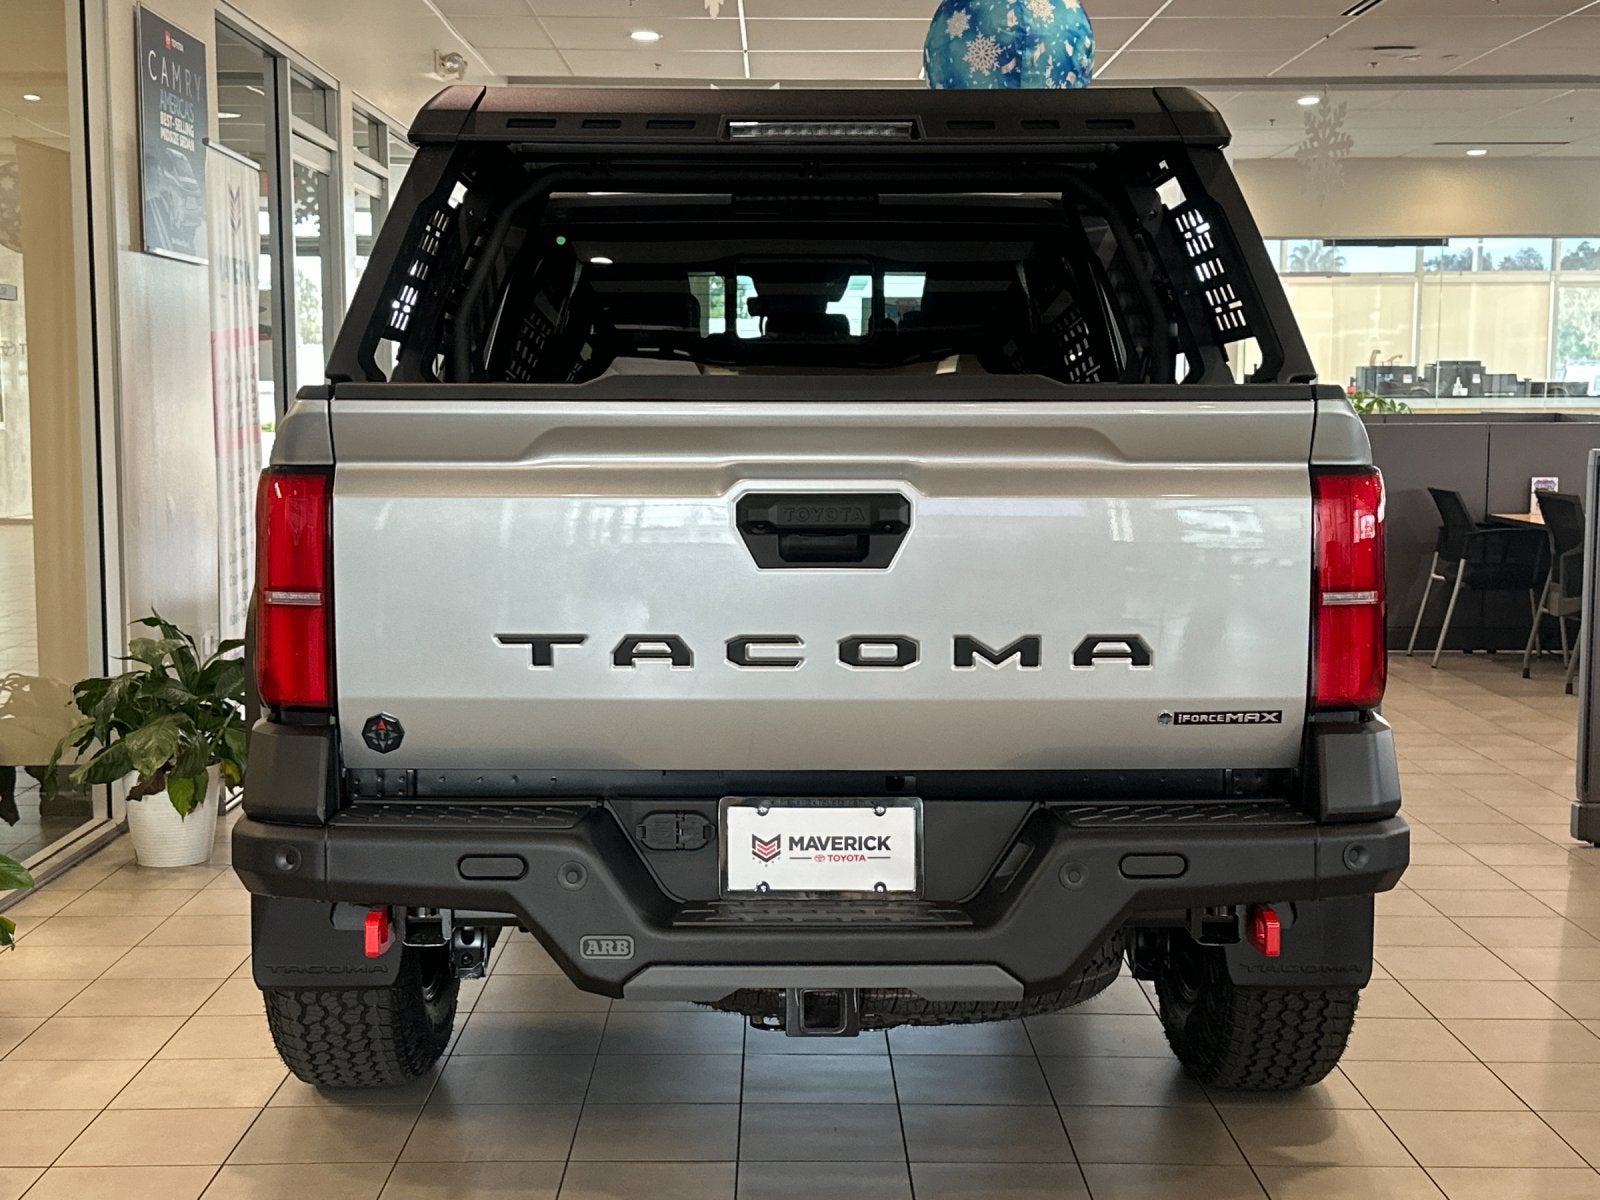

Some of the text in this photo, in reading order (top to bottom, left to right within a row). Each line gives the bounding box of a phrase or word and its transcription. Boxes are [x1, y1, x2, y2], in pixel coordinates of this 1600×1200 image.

[148, 49, 202, 102] CAMRY
[786, 506, 865, 522] TOYOTA
[494, 634, 1153, 671] TACOMA
[788, 835, 892, 851] MAVERICK
[828, 854, 866, 862] TOYOTA
[586, 940, 630, 955] ARB
[265, 965, 389, 976] TACOMA
